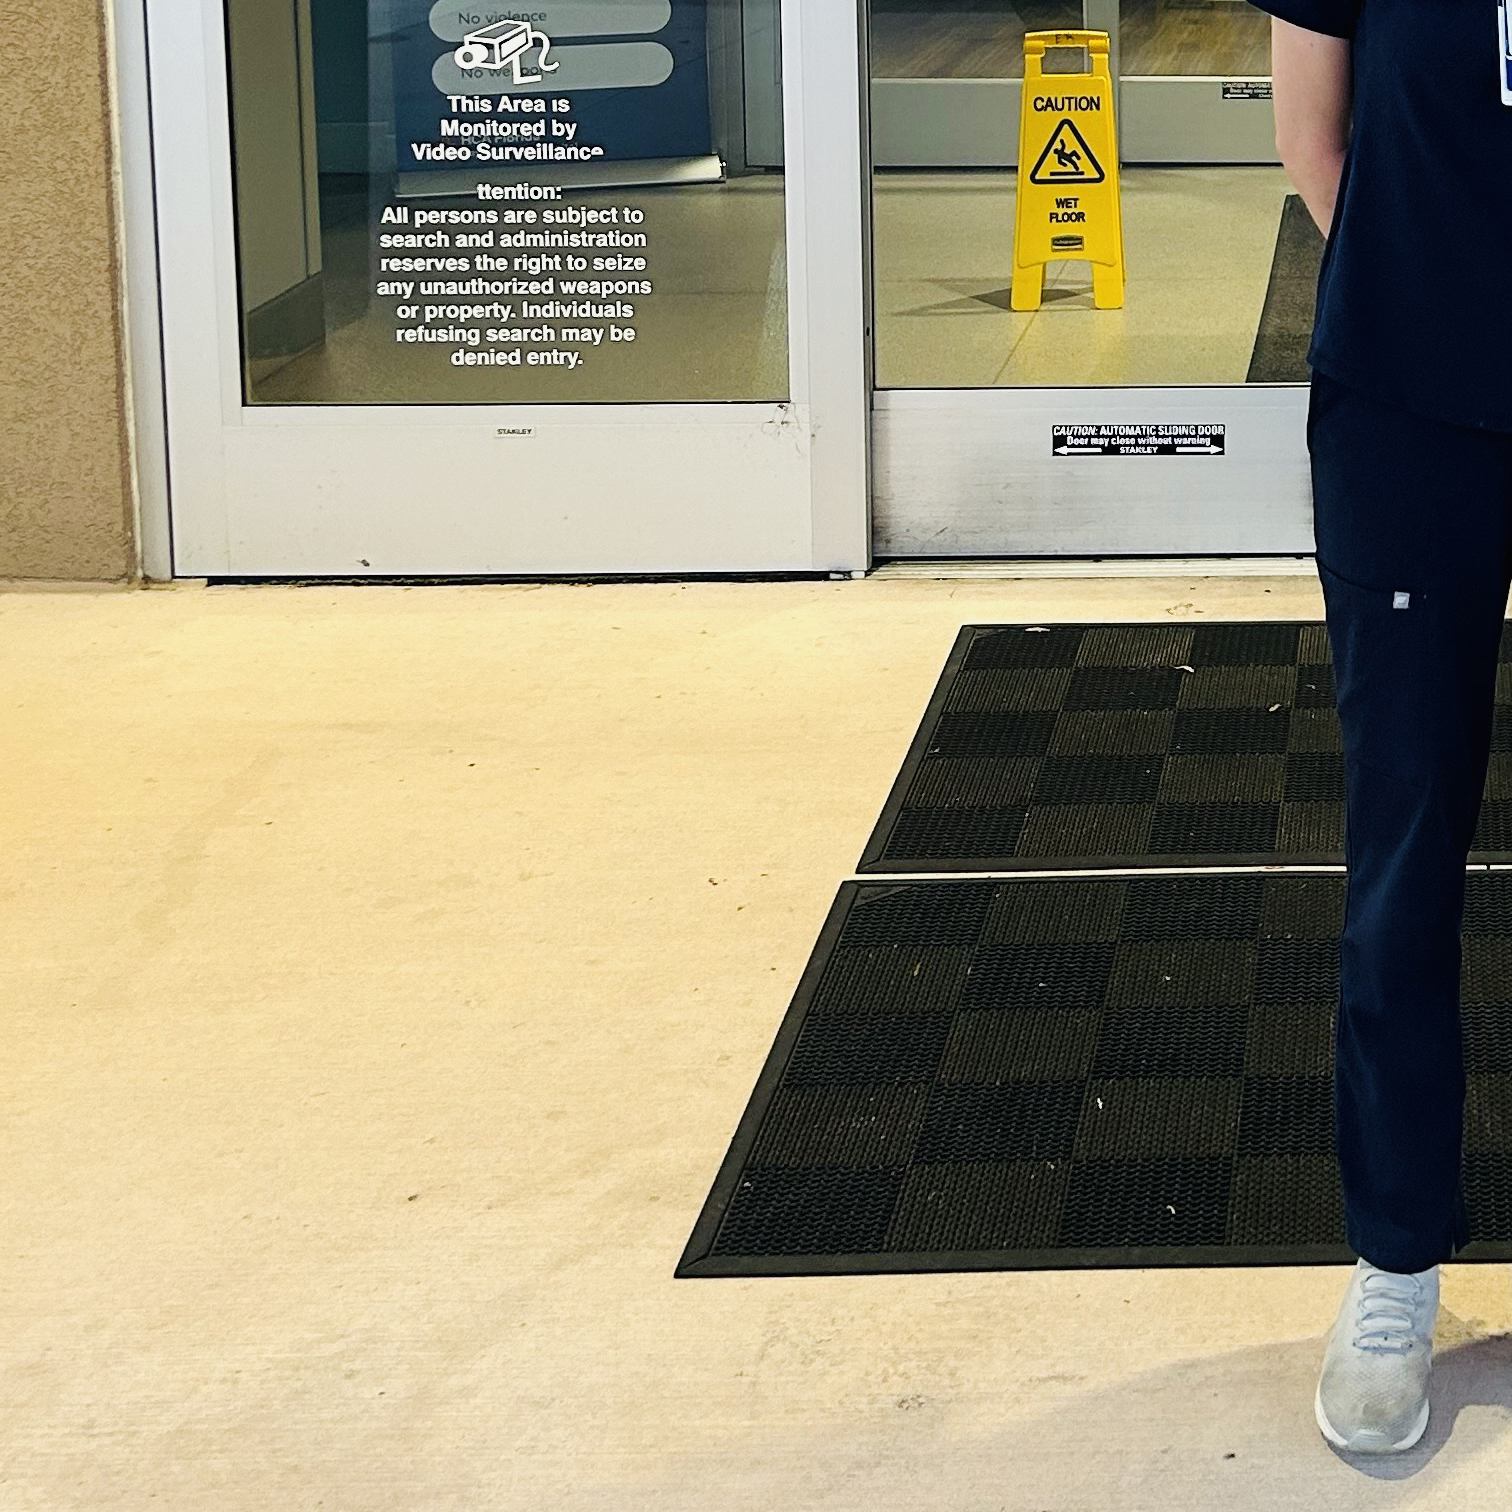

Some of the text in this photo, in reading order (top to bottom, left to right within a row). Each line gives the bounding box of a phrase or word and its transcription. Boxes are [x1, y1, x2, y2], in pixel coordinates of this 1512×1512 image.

[458, 11, 547, 24] No violence
[461, 68, 483, 79] No
[447, 96, 570, 113] This Area is
[1033, 96, 1101, 112] CAUTION
[440, 119, 577, 140] Monitored by
[411, 143, 604, 160] Video Surveillance
[1055, 198, 1079, 209] WET
[381, 207, 644, 228] All persons are subject to
[1049, 212, 1086, 223] FLOOR
[379, 231, 647, 248] search and administration
[380, 254, 646, 275] reserves the right to seize
[377, 278, 652, 299] any unauthorized weapons
[397, 301, 634, 322] or property. Individuals
[396, 325, 636, 346] refusing search may be
[451, 348, 583, 369] denied entry.
[1053, 425, 1225, 436] CAUTION: AUTOMATIC SLIDING DOOR
[1067, 436, 1210, 447] Door may close without warning
[1120, 446, 1158, 454] STANLEY
